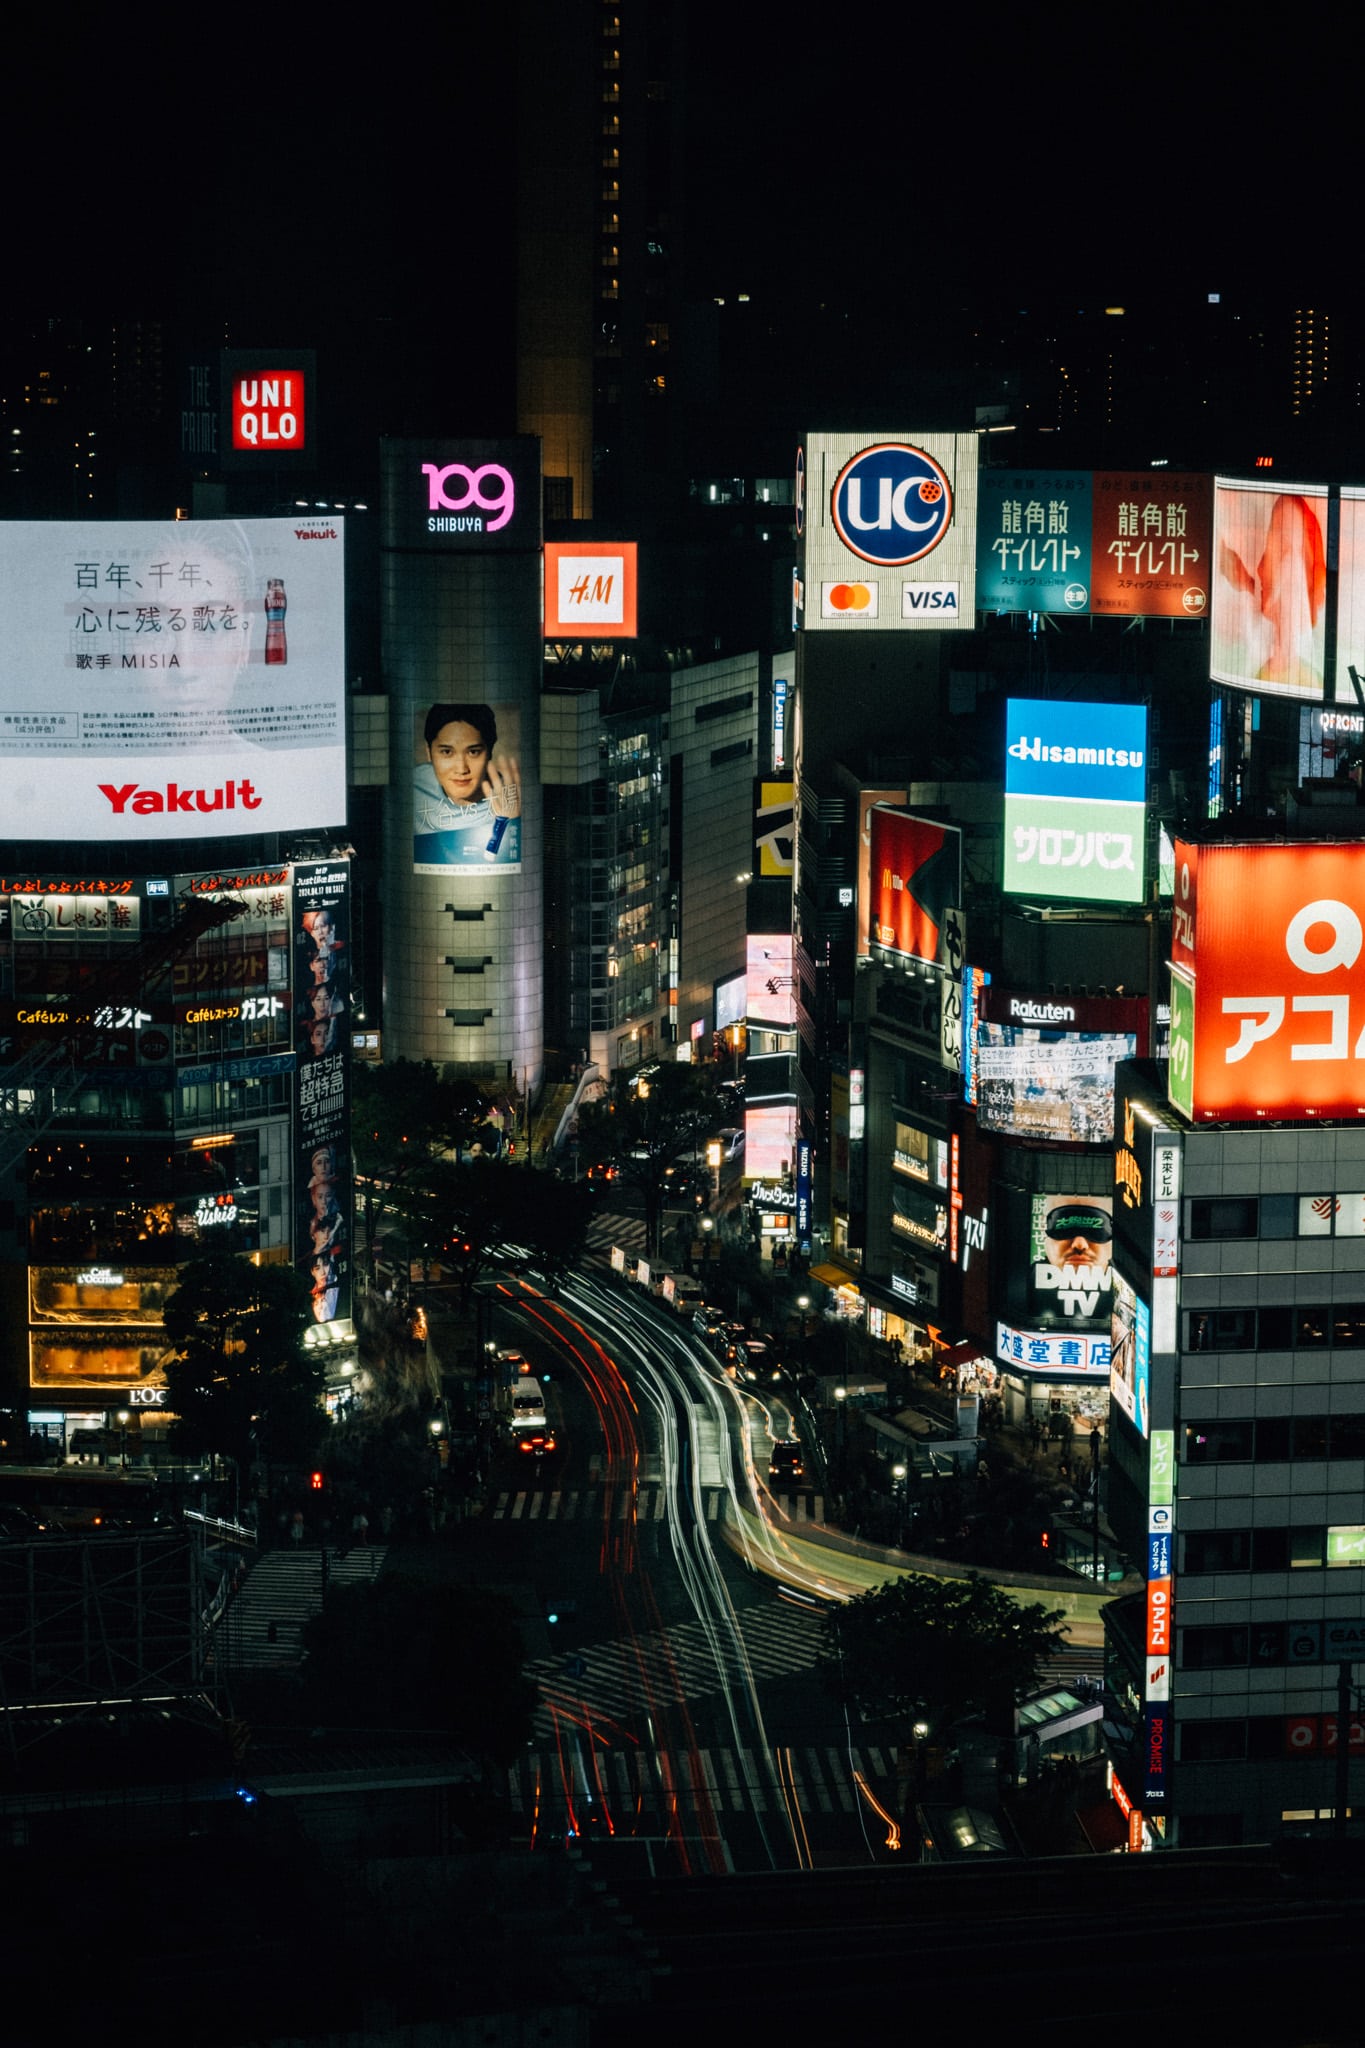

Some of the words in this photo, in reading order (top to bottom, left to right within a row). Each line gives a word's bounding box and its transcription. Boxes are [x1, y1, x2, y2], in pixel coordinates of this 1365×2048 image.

[189, 366, 210, 407] THE
[241, 379, 292, 408] UNI
[182, 410, 217, 453] PRIME
[241, 412, 297, 445] QLO
[422, 463, 515, 532] 109
[427, 517, 483, 533] SHIBUYA
[1001, 500, 1069, 534] 龍角散
[1118, 502, 1187, 537] 龍角散
[294, 529, 338, 540] Yakult
[991, 538, 1081, 572] ダイレクト
[1107, 541, 1200, 576] ダイレクト
[74, 562, 213, 589] 百年、千年、
[569, 574, 614, 604] H&M
[1118, 580, 1153, 590] スティック
[906, 591, 957, 609] VISA
[75, 605, 250, 634] 心に残る歌を。
[76, 653, 111, 670] 歌手
[121, 654, 181, 669] MISIA
[1320, 713, 1365, 733] QFRONT
[1008, 736, 1143, 768] Hisamitsu
[98, 779, 263, 815] Yakult
[416, 799, 457, 833] 大谷
[1013, 826, 1135, 871] サロンパス
[1, 879, 134, 895] しゃぶしゃぶバイキング
[57, 905, 131, 929] しゃぶ葉
[1175, 905, 1194, 952] アコム
[240, 996, 285, 1020] ガスト
[1011, 999, 1075, 1021] Rakuten
[1171, 986, 1190, 1081] レイク
[300, 1052, 344, 1083] 僕たちは
[300, 1070, 344, 1106] 超特急
[752, 1180, 797, 1207] グルメタウン
[963, 1208, 989, 1272] クスリ
[1035, 1263, 1112, 1291] DMM
[1057, 1290, 1100, 1316] TV
[1001, 1330, 1111, 1366] 大盛堂書店
[1154, 1437, 1168, 1475] レイク
[1152, 1607, 1166, 1645] アコム
[1149, 1717, 1163, 1774] PROMISE
[1145, 1790, 1165, 1798] プロミス
